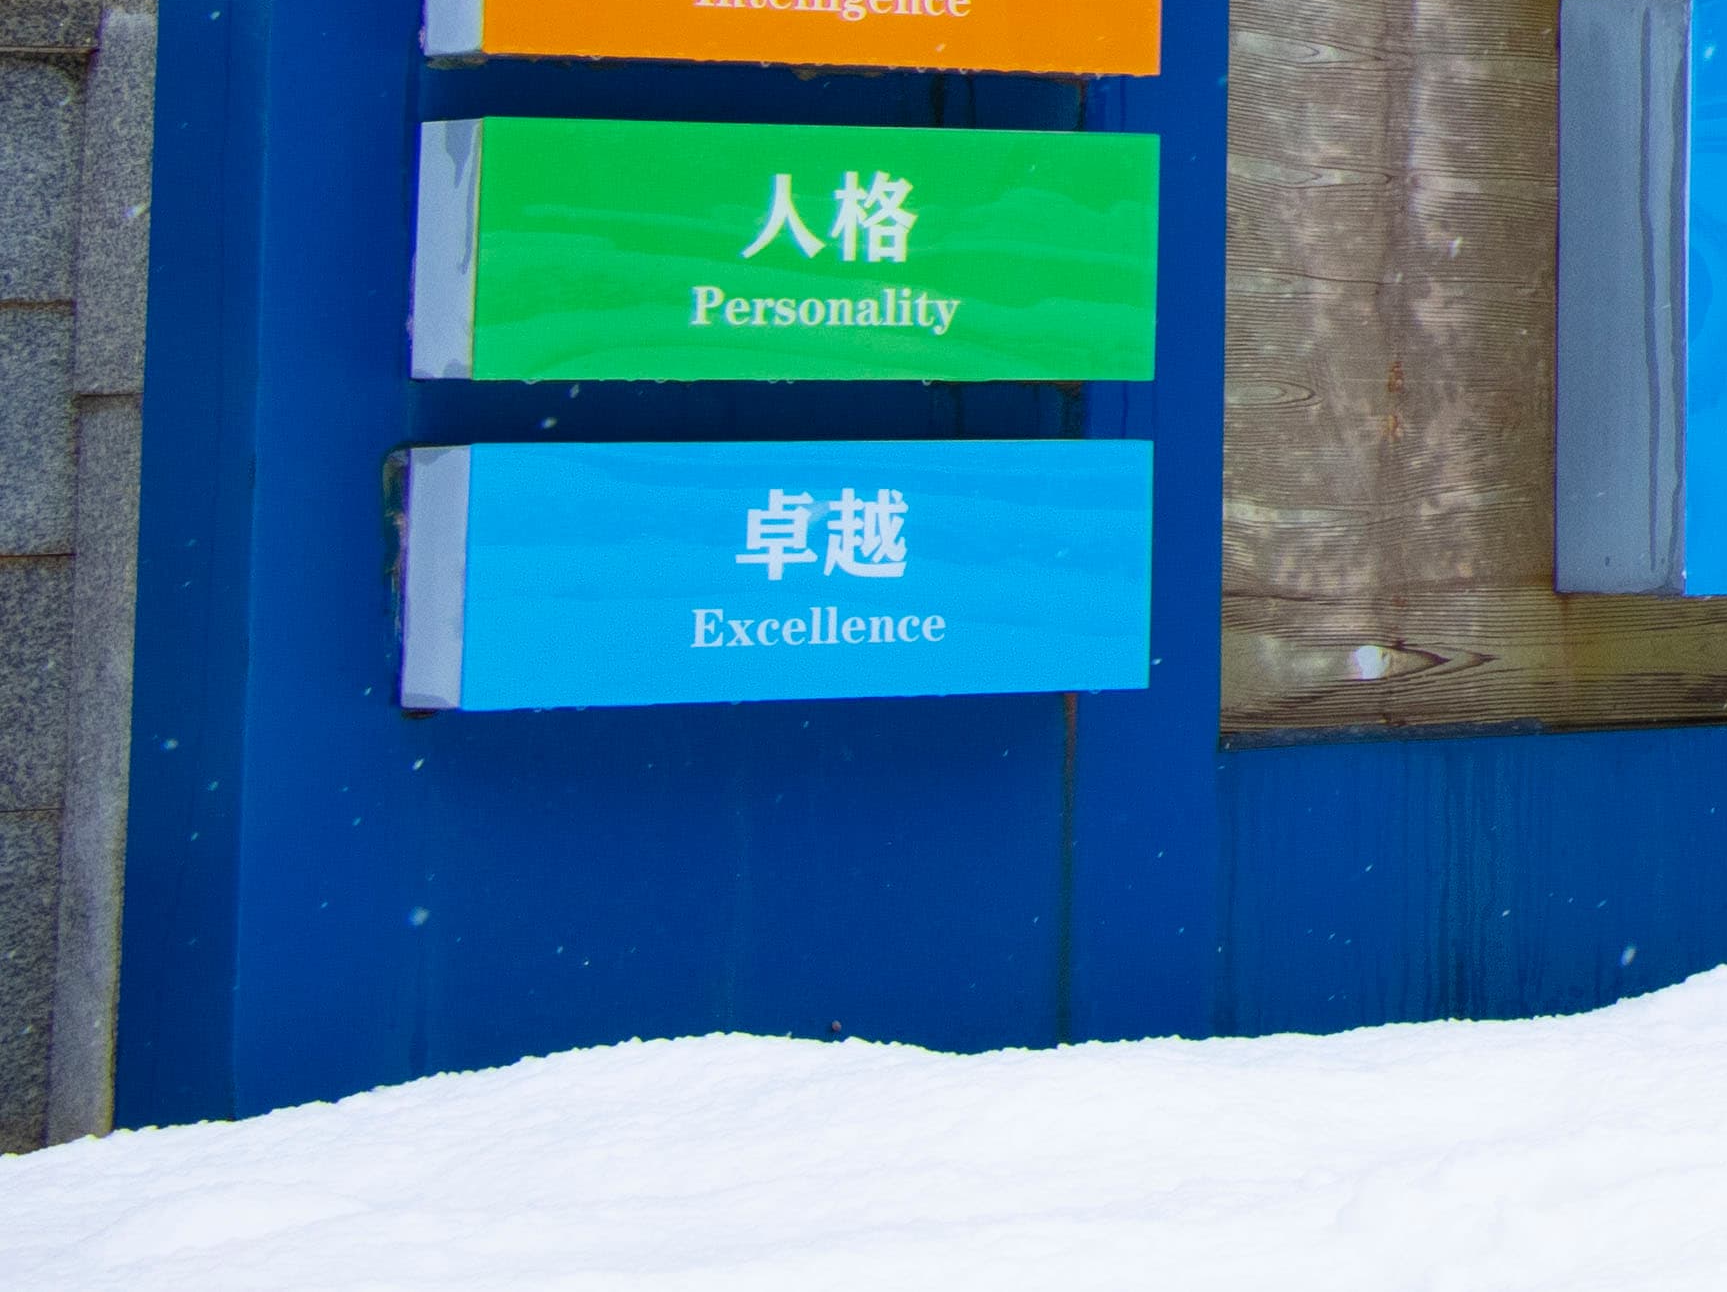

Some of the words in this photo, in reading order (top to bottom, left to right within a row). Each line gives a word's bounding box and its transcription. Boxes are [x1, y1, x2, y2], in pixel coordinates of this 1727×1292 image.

[741, 170, 918, 263] 人格
[690, 284, 961, 337] Personality
[734, 487, 910, 582] 卓越
[690, 605, 947, 650] Excellence
